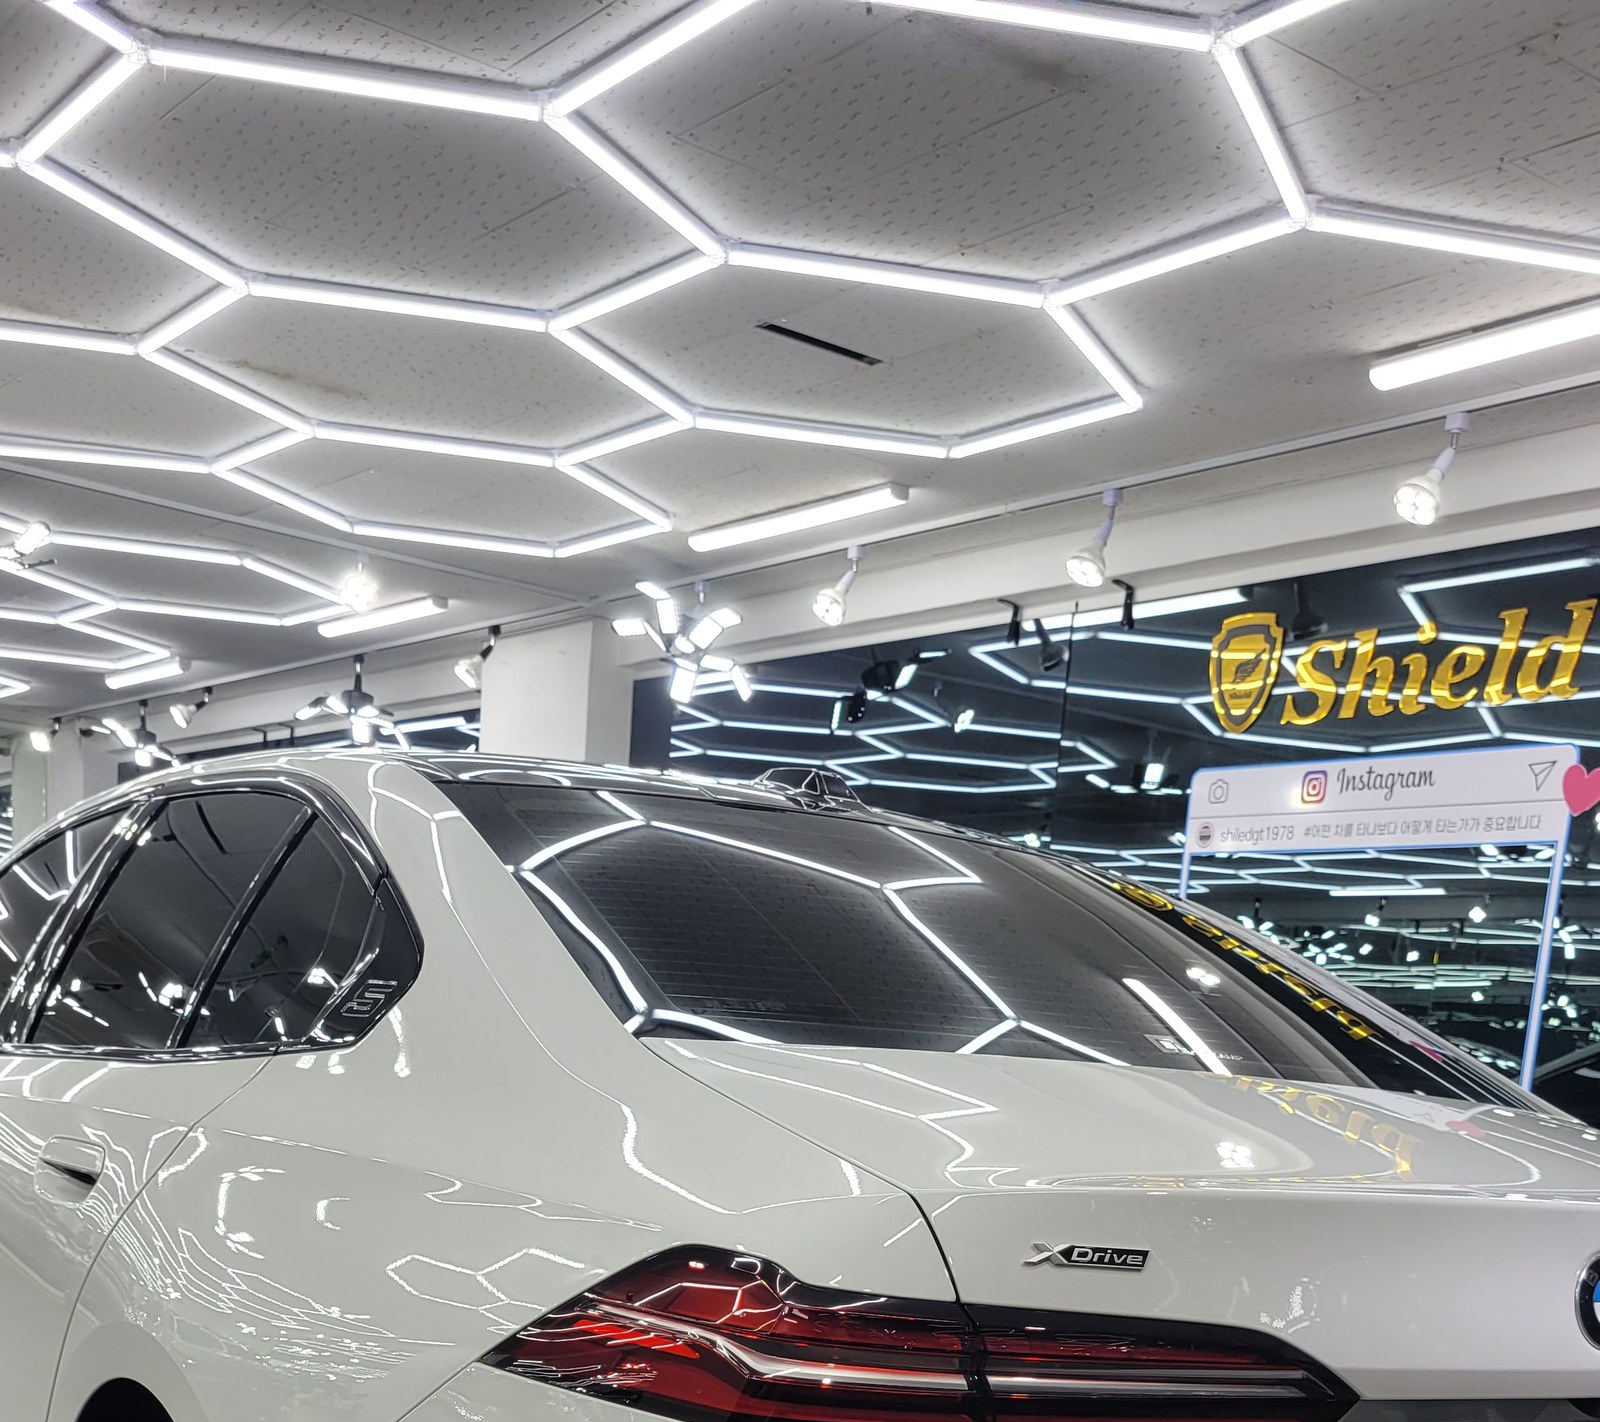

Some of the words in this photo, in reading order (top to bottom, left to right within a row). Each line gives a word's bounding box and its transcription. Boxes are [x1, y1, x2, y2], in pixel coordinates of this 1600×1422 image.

[1280, 598, 1598, 726] Shield
[1337, 766, 1436, 801] Instagram
[1483, 814, 1542, 833] 중요합니다
